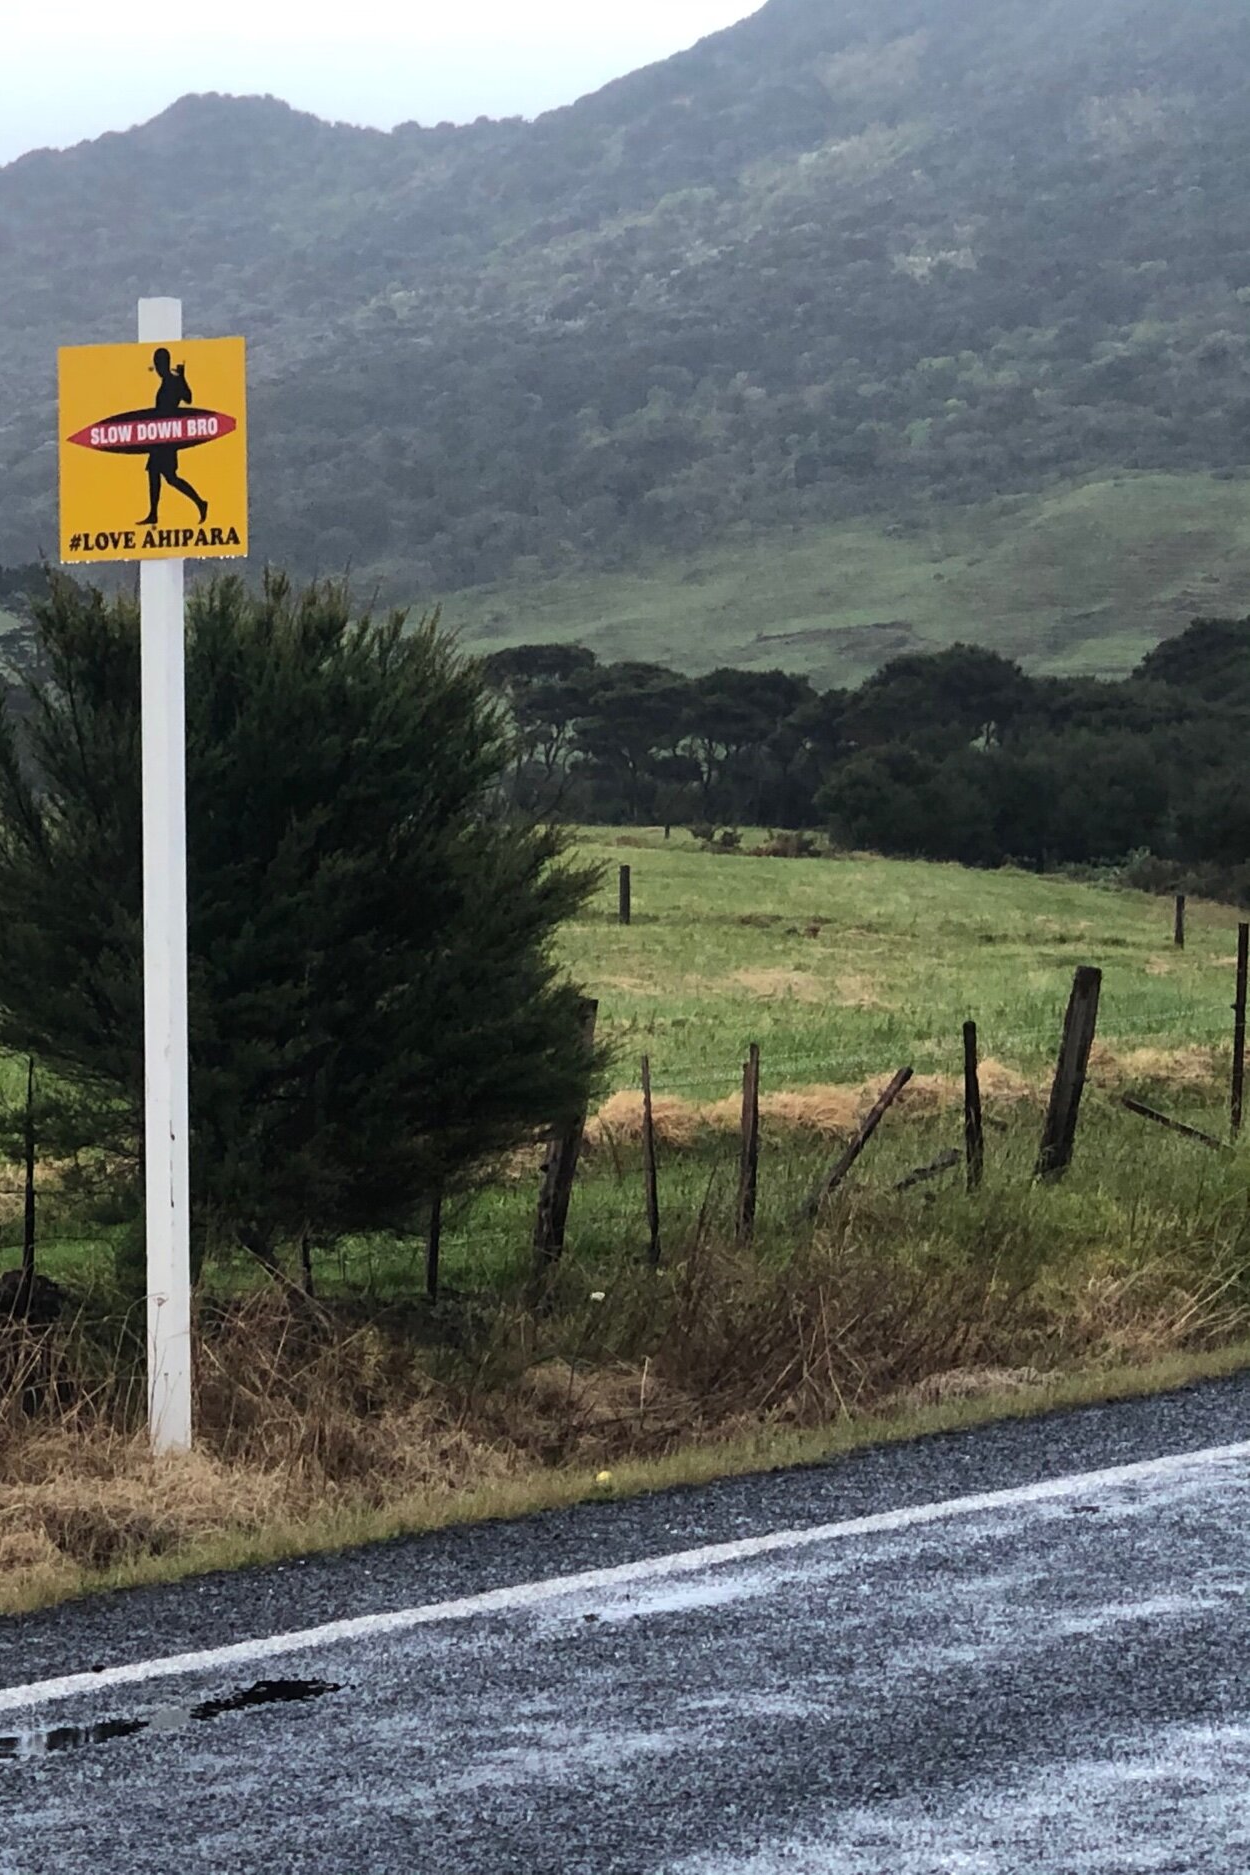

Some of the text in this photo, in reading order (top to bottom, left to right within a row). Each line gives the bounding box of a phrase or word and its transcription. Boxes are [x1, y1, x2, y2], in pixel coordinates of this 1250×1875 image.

[90, 417, 218, 445] SLOW DOWN BRO
[69, 527, 240, 551] #LOVE AHIPARA
